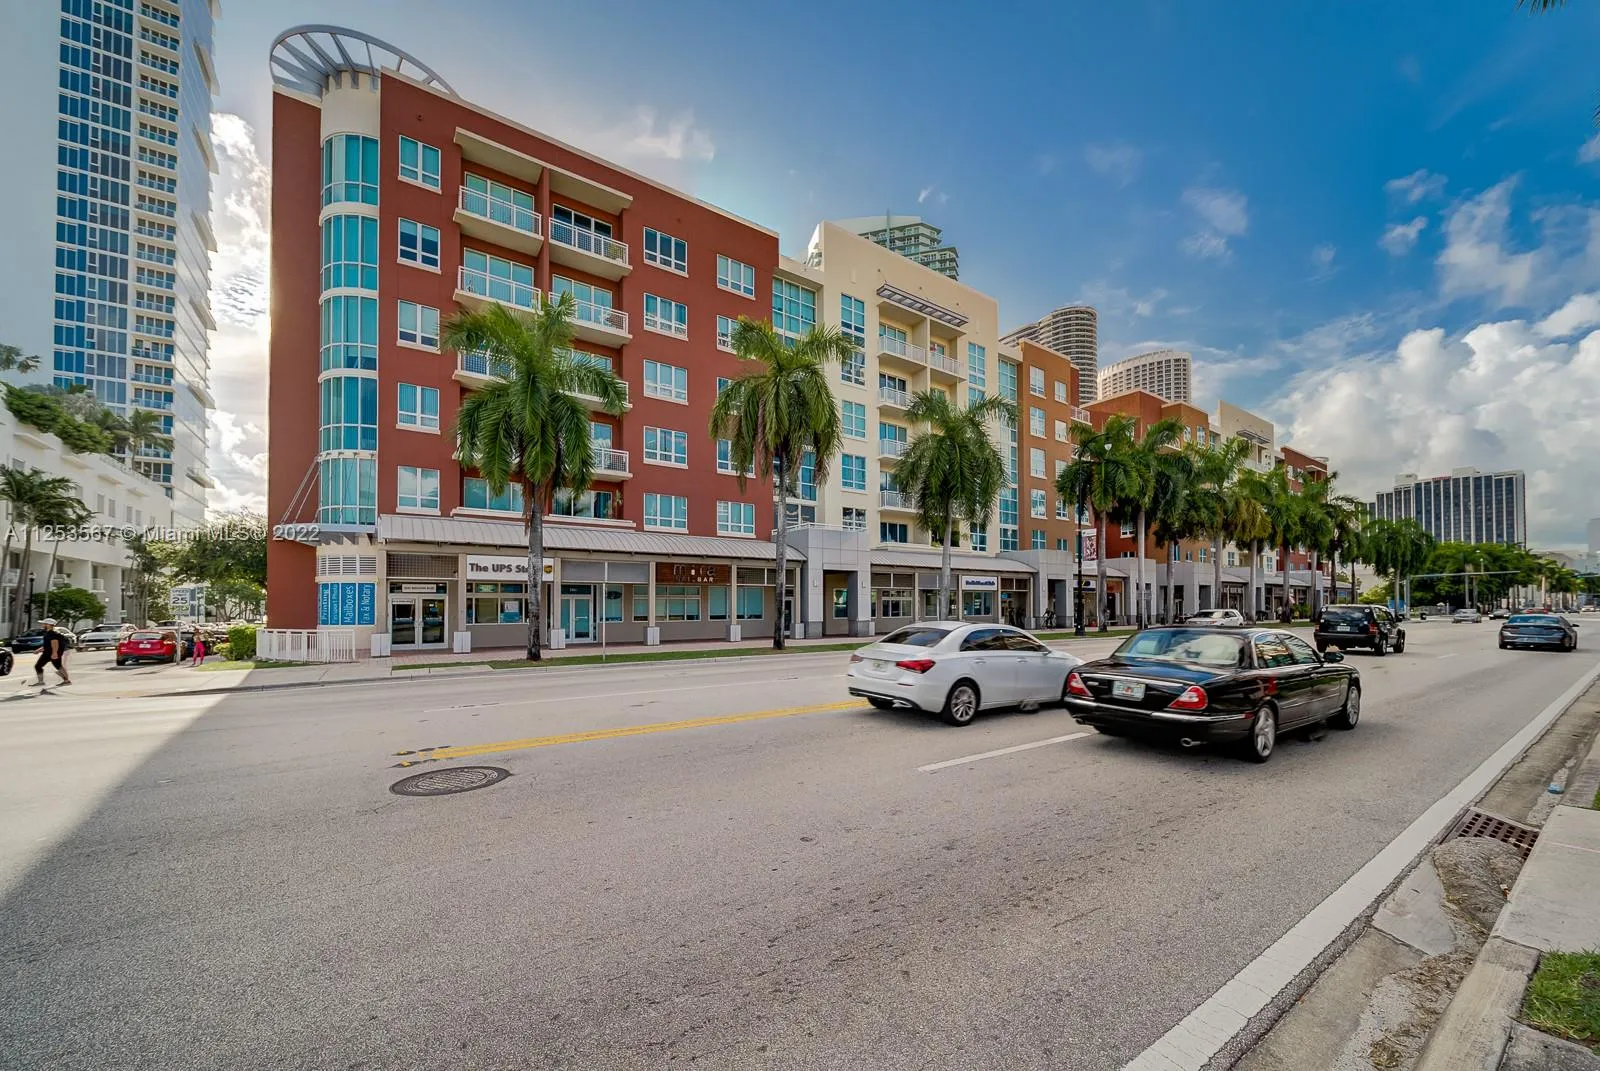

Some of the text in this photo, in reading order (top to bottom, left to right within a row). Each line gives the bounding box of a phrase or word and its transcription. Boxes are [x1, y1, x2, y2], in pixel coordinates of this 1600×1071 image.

[469, 562, 489, 573] The
[492, 563, 512, 573] UPS
[172, 596, 187, 604] 25
[360, 584, 373, 605] Notary
[343, 585, 354, 623] Mailboxes
[360, 612, 370, 624] Fax
